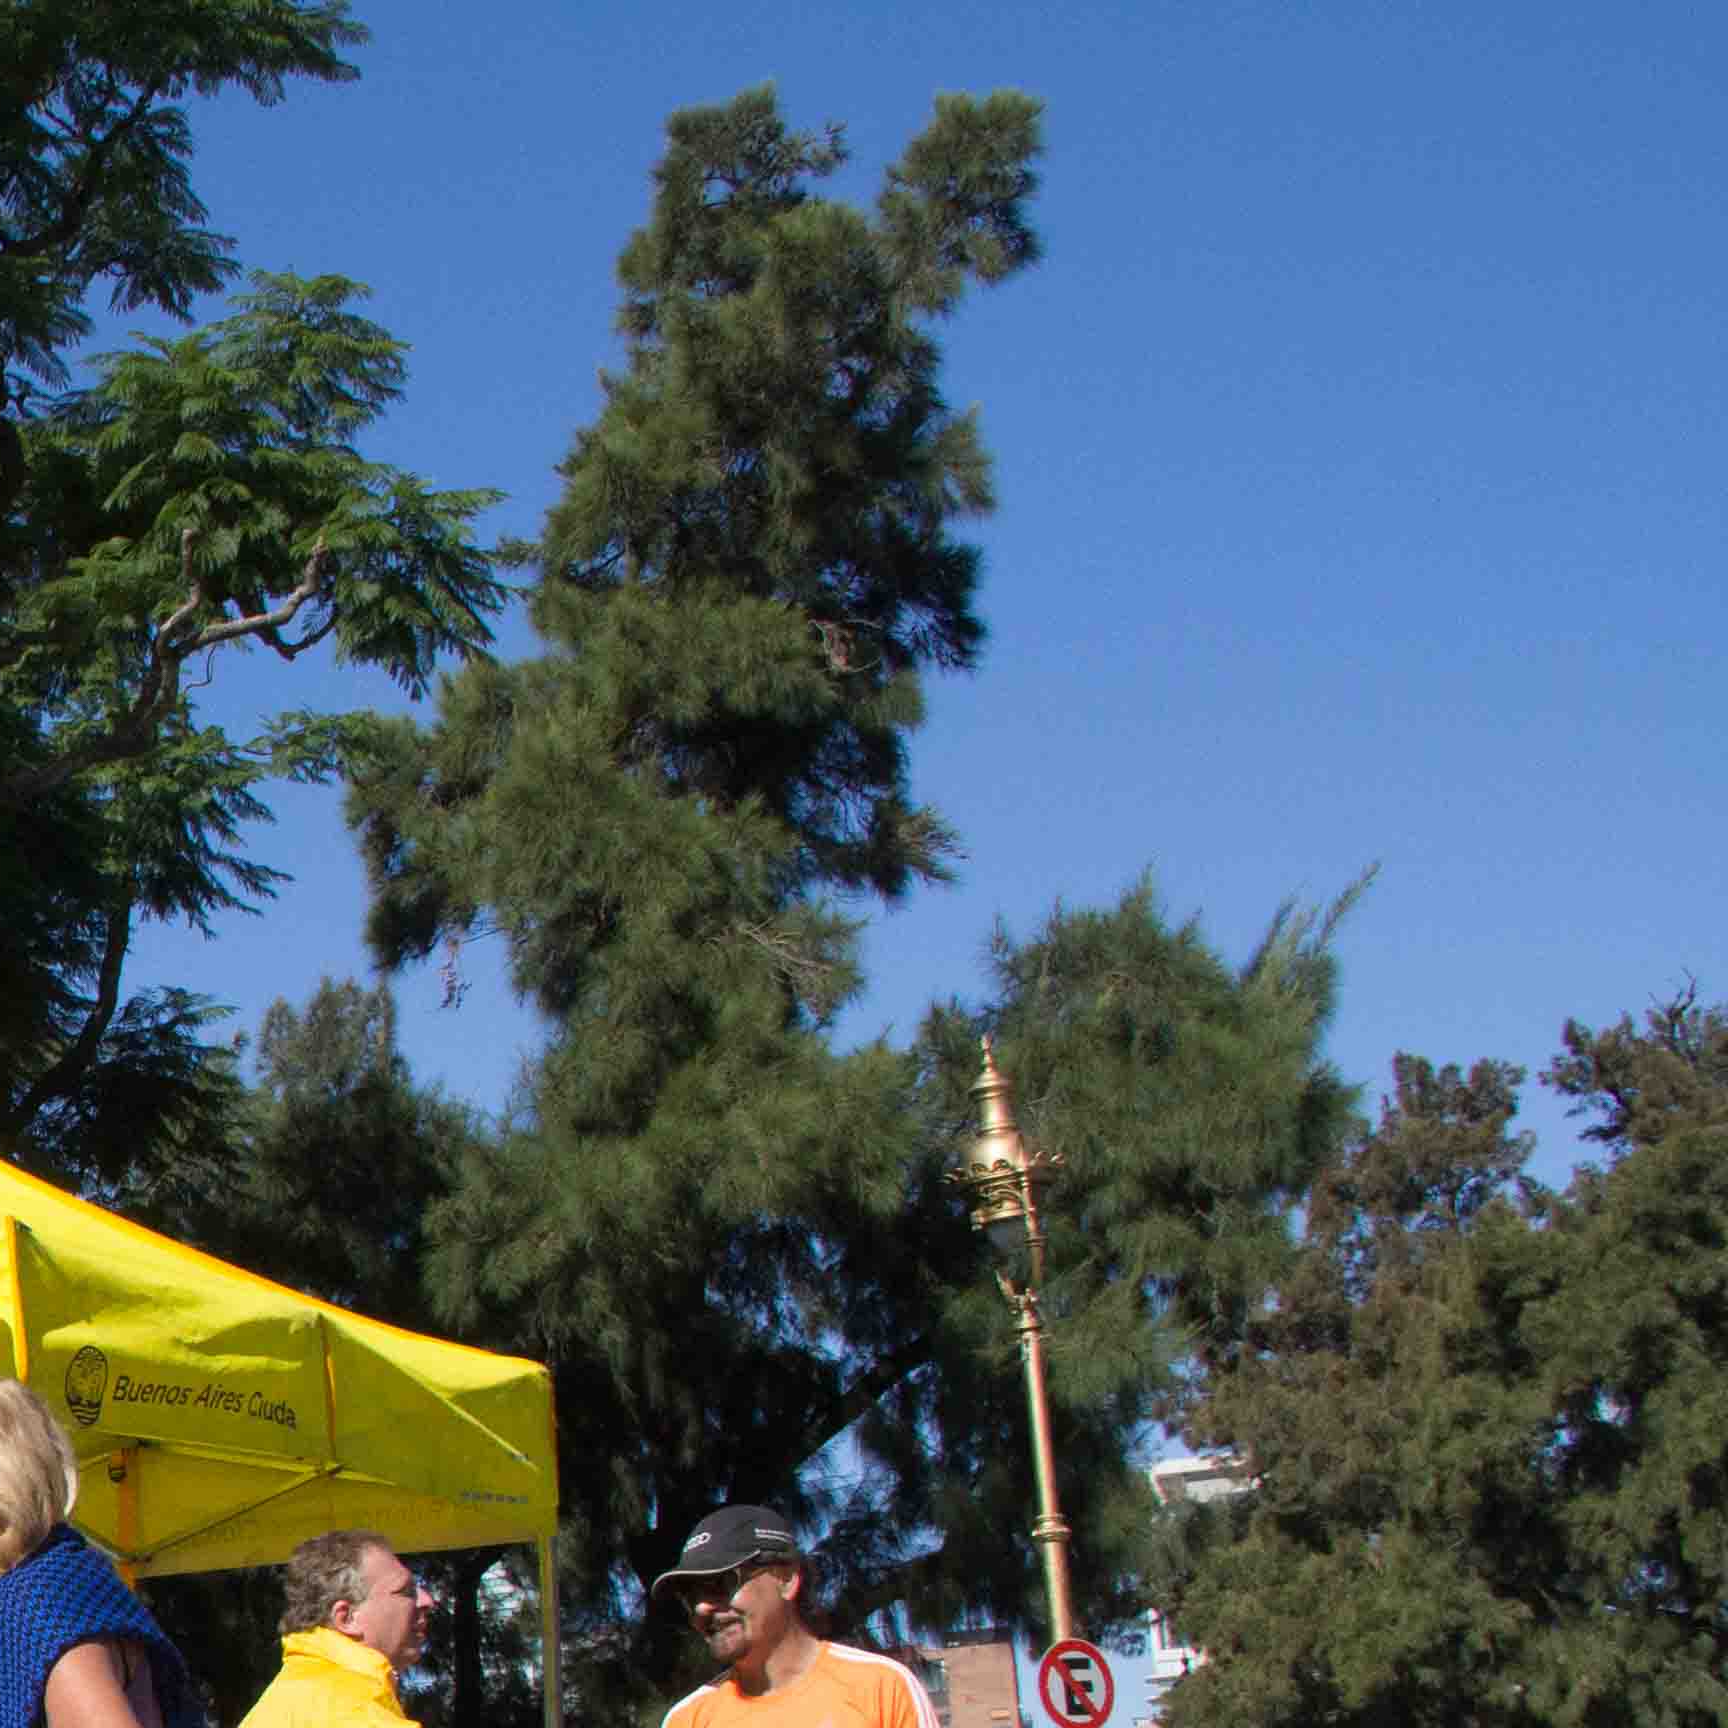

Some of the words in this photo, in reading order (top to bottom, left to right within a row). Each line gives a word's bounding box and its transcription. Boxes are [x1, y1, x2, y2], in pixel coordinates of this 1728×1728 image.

[112, 1375, 193, 1405] Buenos
[193, 1383, 244, 1413] Aires
[247, 1391, 298, 1431] Ciuda
